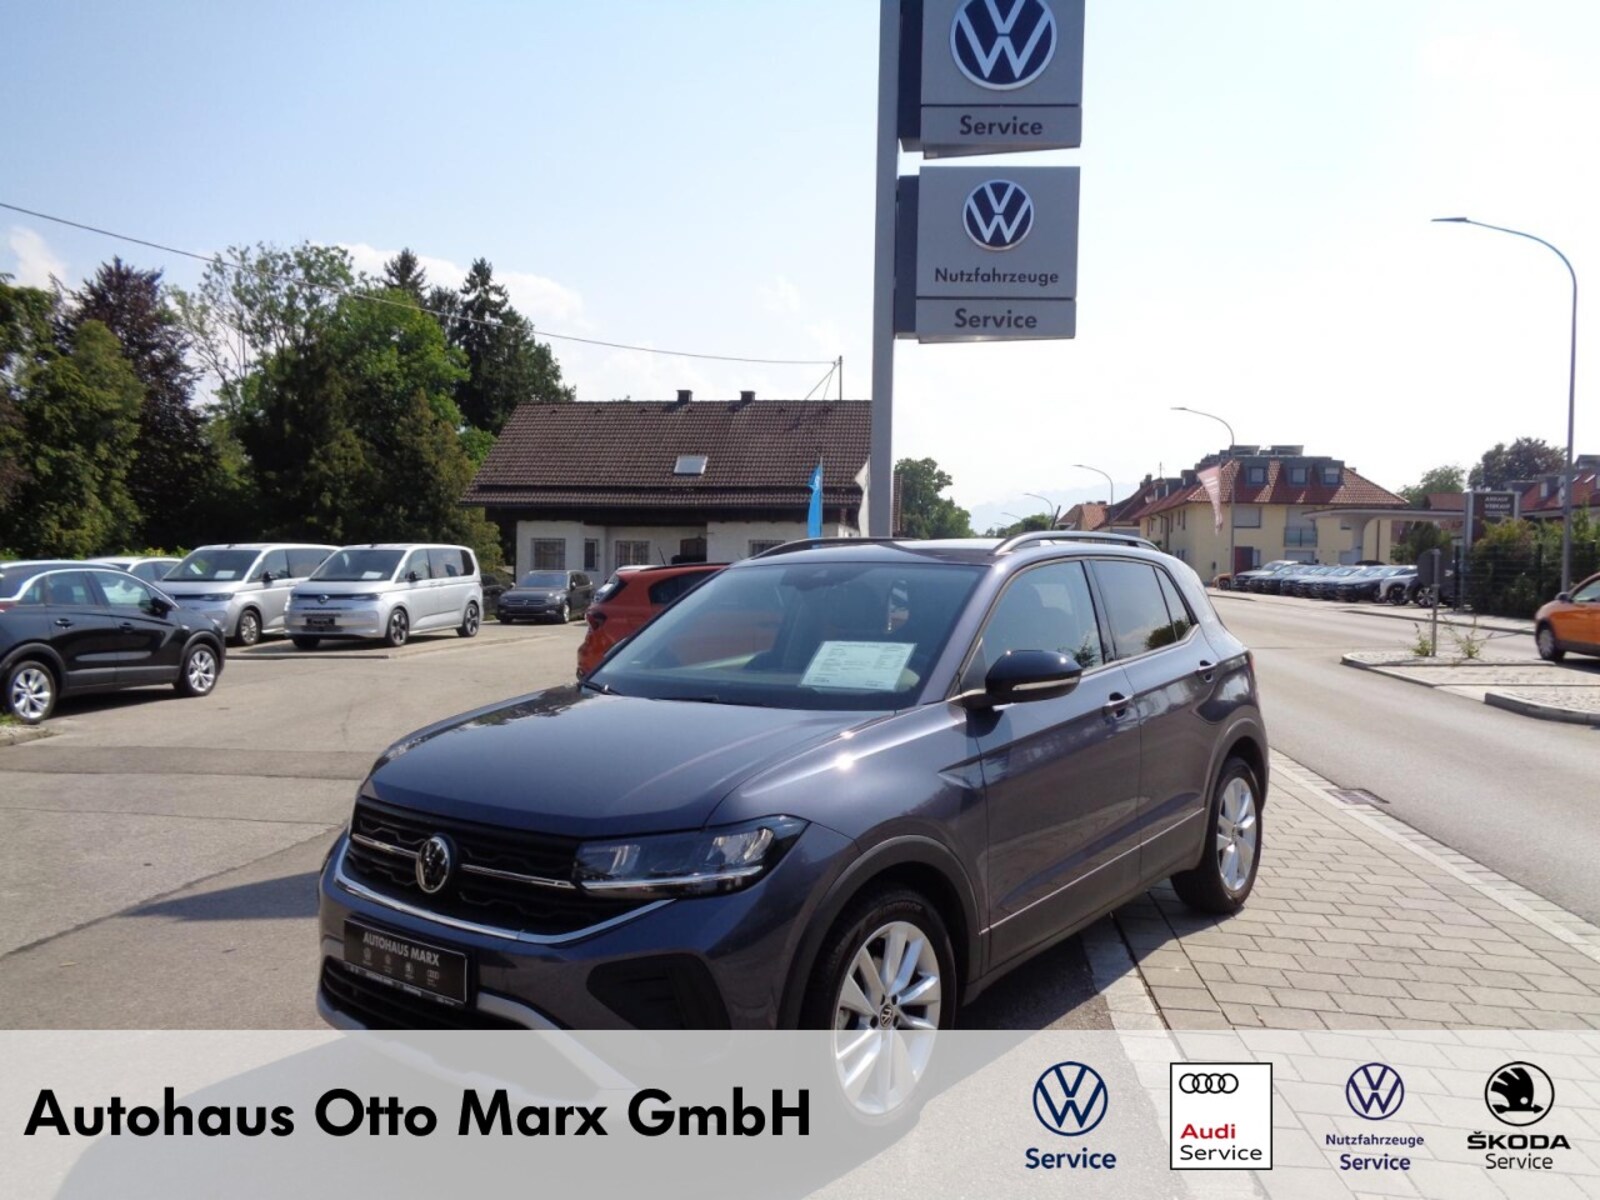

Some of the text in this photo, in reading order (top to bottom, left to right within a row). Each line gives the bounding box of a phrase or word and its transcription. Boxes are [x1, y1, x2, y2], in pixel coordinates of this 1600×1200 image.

[960, 115, 1043, 136] Service
[934, 267, 1059, 287] Nutzfahrzeuge
[954, 308, 1037, 329] Service
[362, 931, 440, 966] AUTOHAUS MARX
